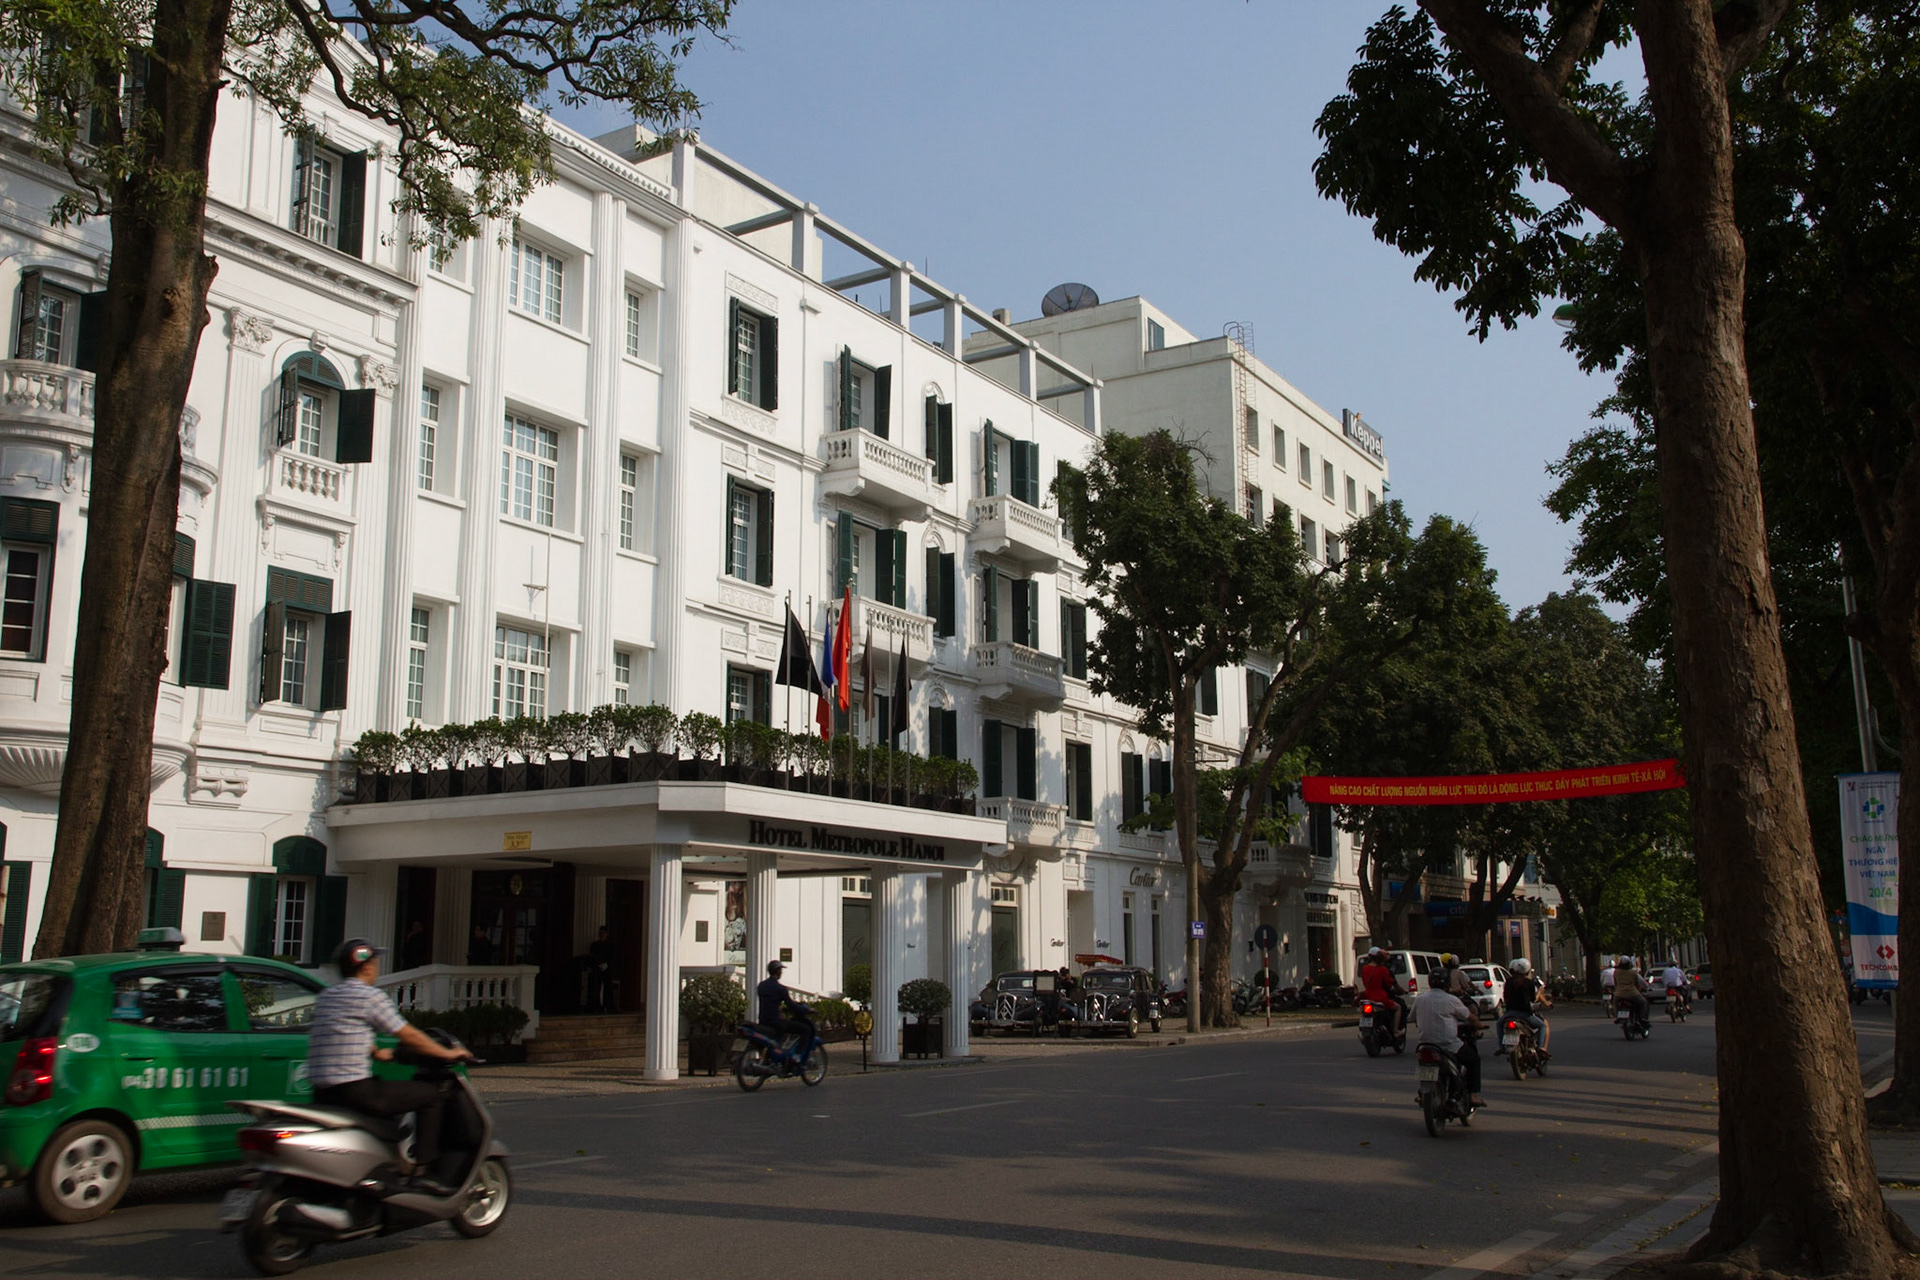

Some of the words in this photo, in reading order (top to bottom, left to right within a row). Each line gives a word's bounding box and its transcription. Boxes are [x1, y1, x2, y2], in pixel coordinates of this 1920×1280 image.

[1350, 413, 1384, 458] Keppel
[1348, 785, 1362, 796] CAO
[1612, 773, 1630, 785] KINH
[749, 820, 807, 848] HOTEL
[810, 827, 899, 857] METROPOLE
[901, 837, 945, 861] HANOI
[1129, 866, 1158, 887] Cartier
[1877, 870, 1896, 878] NAM
[1868, 887, 1893, 898] 20/4
[171, 1067, 195, 1088] 61
[200, 1067, 222, 1088] 61
[227, 1067, 249, 1088] 61
